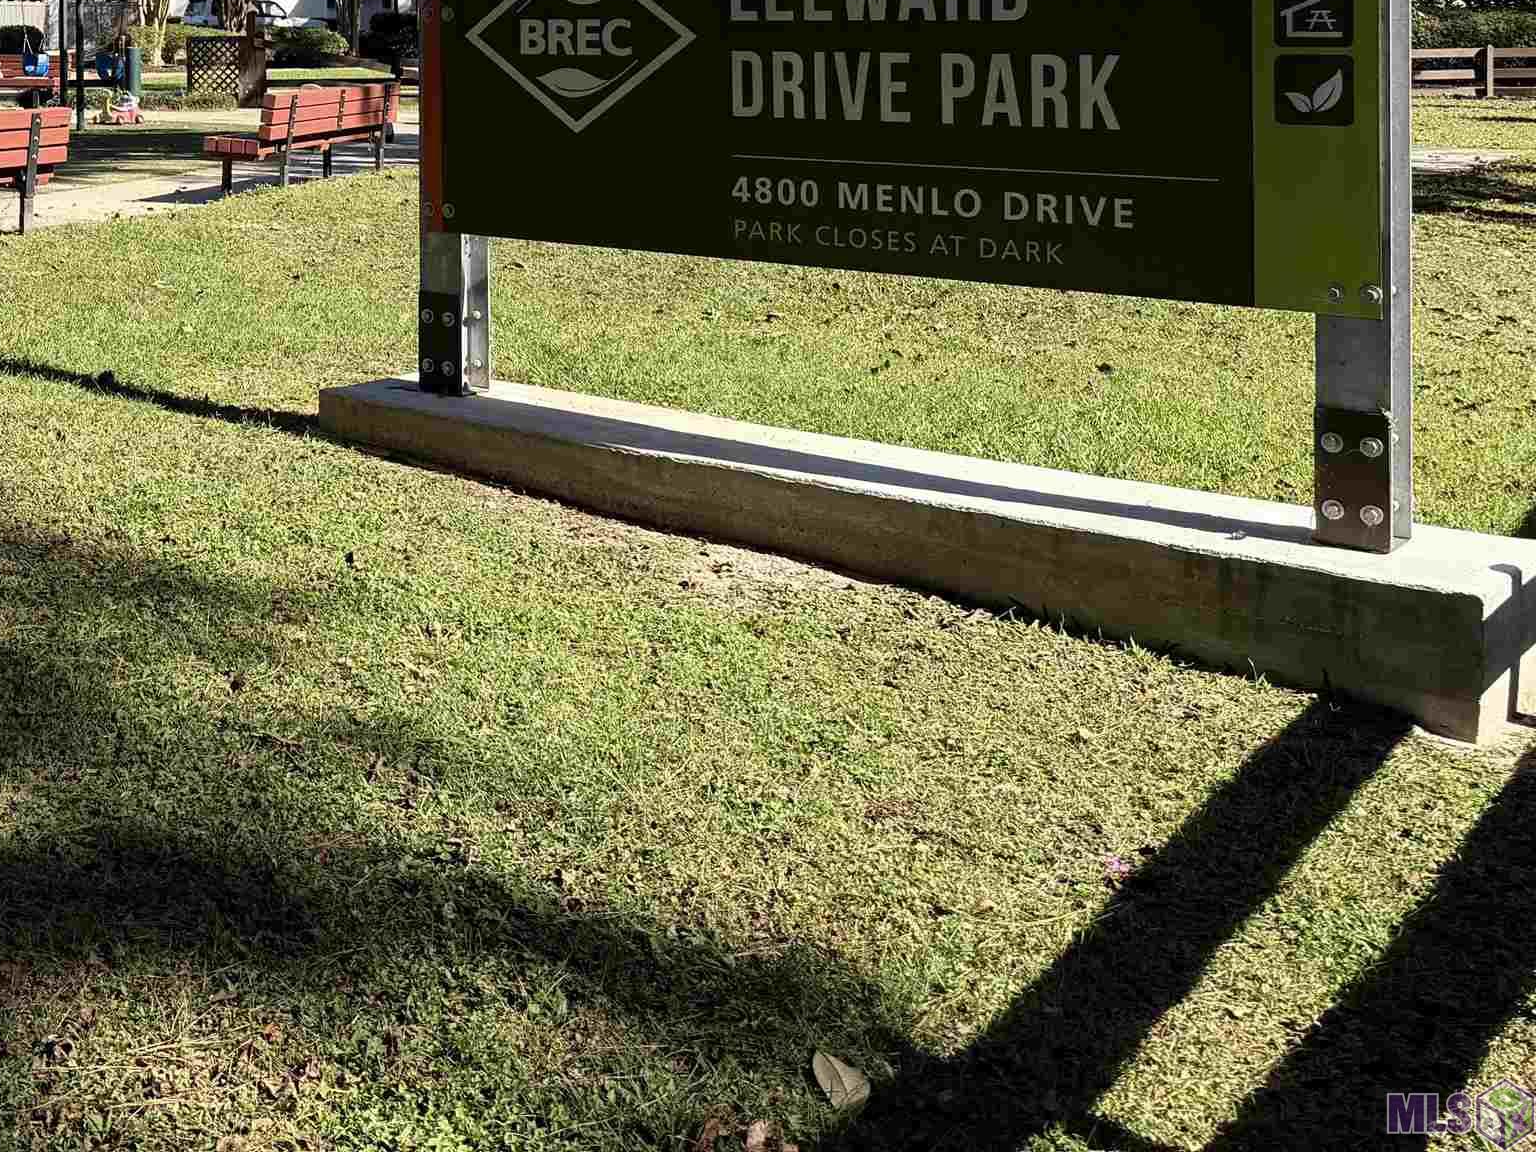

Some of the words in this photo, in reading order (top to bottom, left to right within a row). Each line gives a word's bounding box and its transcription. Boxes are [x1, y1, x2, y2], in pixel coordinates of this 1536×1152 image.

[519, 19, 634, 57] BREC
[731, 51, 912, 123] DRIVE
[940, 53, 1123, 132] PARK
[731, 176, 820, 208] 4800
[838, 182, 983, 218] MENLO
[1003, 192, 1135, 229] DRIVE
[733, 219, 803, 245] PARK
[815, 225, 918, 253] CLOSES
[929, 234, 968, 258] AT
[979, 238, 1065, 266] DARK
